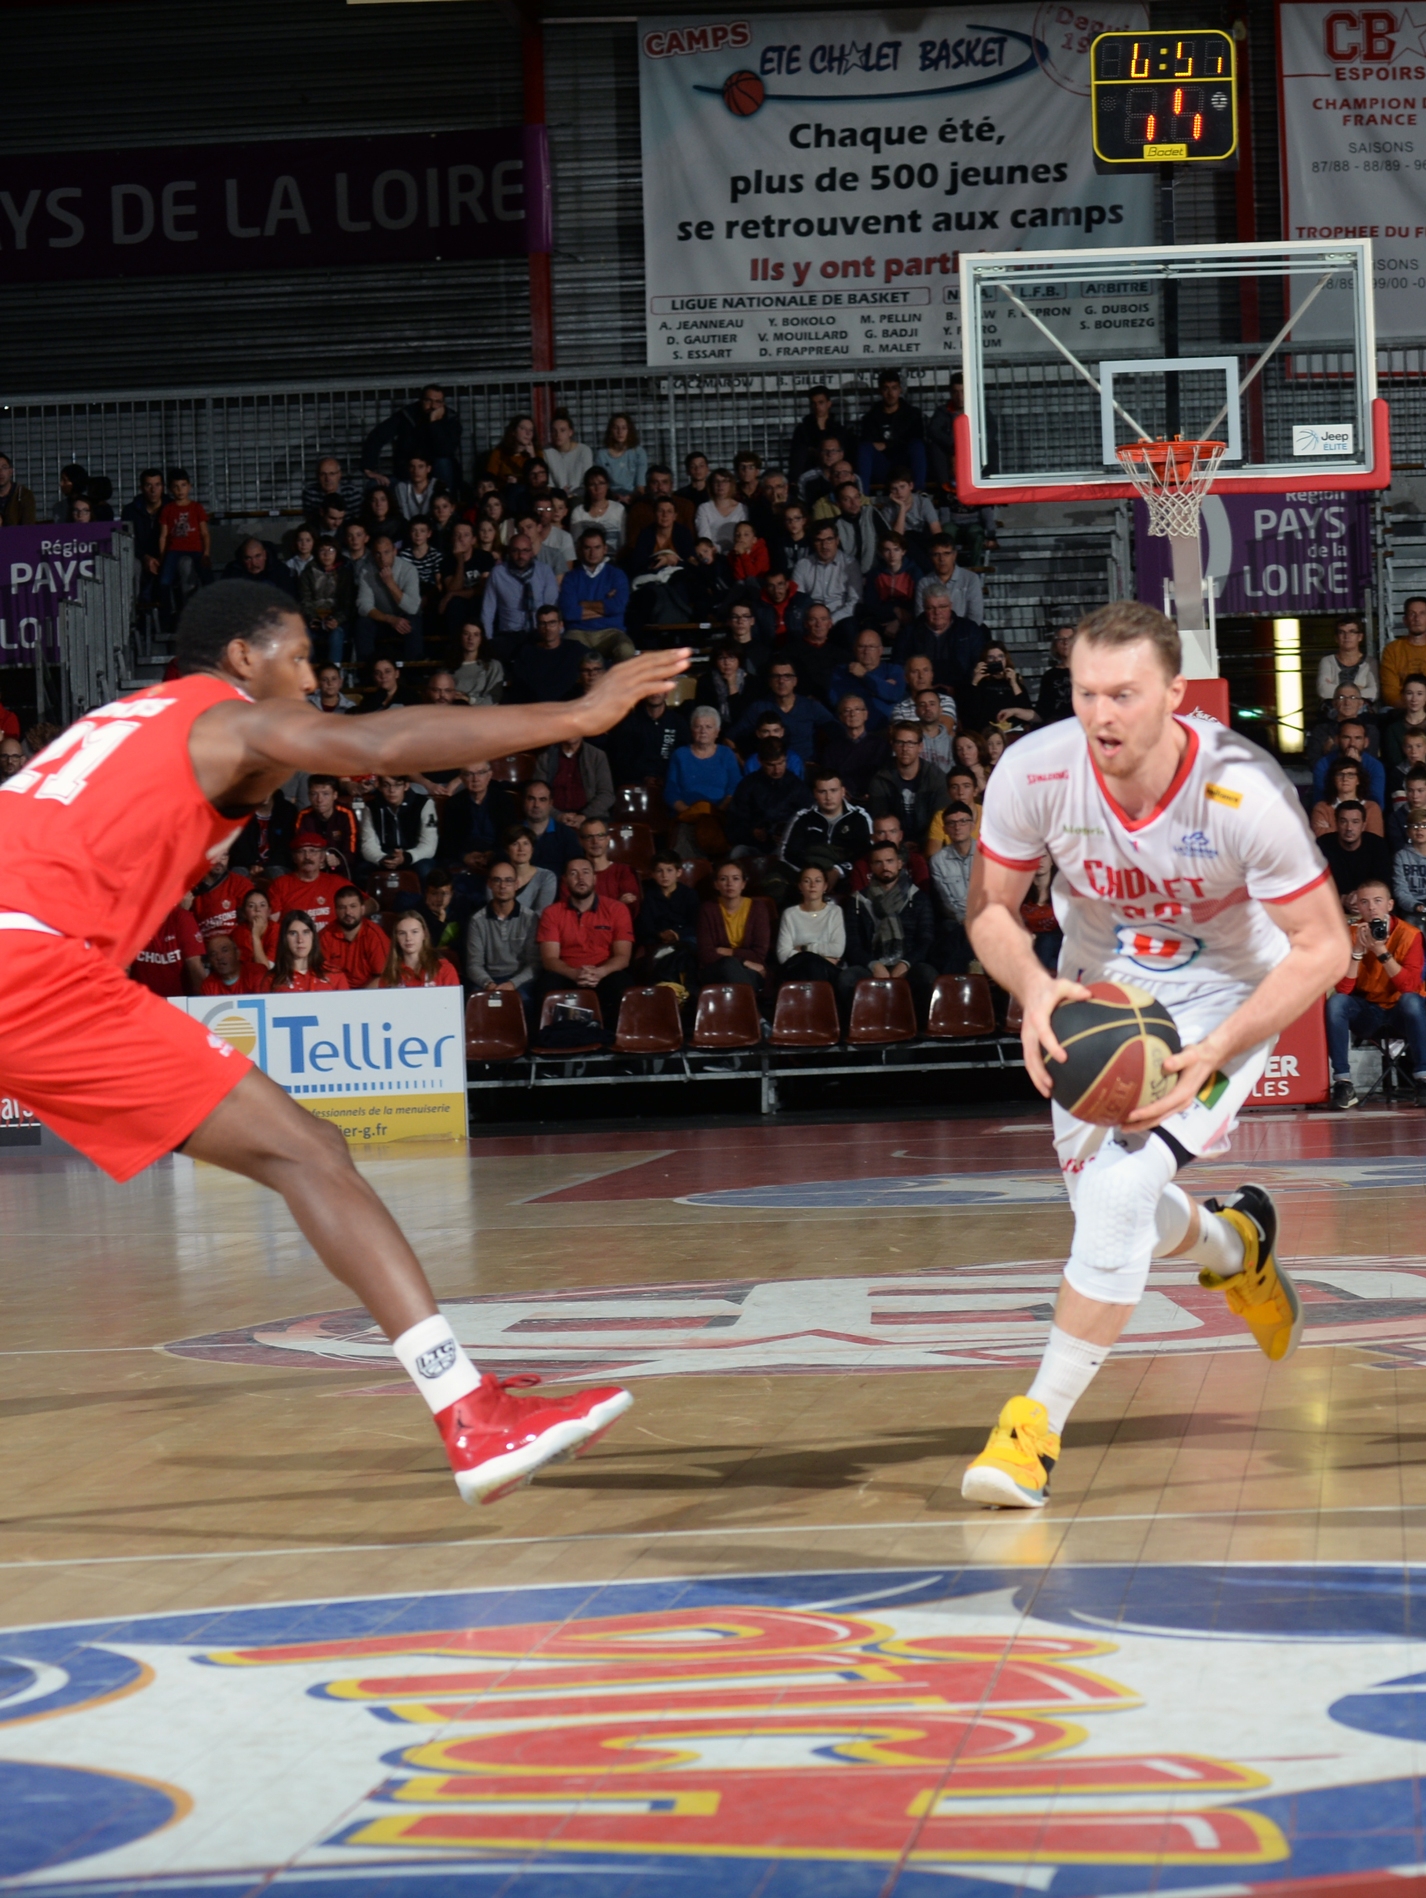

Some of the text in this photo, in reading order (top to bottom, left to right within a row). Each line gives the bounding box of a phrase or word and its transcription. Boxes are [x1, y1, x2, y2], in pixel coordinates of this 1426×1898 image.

[645, 22, 750, 57] CAMPS
[1323, 9, 1400, 64] CB
[761, 37, 1007, 75] ETE BASKET
[1336, 66, 1426, 81] ESPOIRS
[1312, 98, 1416, 110] CHAMPION
[1342, 114, 1417, 126] FRANCE
[789, 116, 1006, 154] Chaque été,
[1146, 146, 1184, 157] Bodet
[1349, 141, 1414, 153] SAISONS
[1312, 161, 1350, 173] 87/88
[1363, 160, 1400, 172] 88/89
[730, 162, 1068, 203] plus de 500 jeunes
[110, 160, 526, 244] DE LA LOIRE
[677, 204, 1123, 241] se retrouvent aux camps
[1296, 226, 1379, 238] TROPHEE
[1385, 226, 1409, 238] DU
[750, 256, 875, 287] Ils y ont
[1020, 286, 1060, 298] L.F.B.
[1086, 281, 1148, 294] ARBITRE
[671, 292, 910, 310] LIGUE NATIONALE DE BASKET
[1085, 303, 1149, 315] G. DUBOIS
[659, 319, 744, 330] A. JEANNEAU
[769, 316, 836, 327] Y. BOKOLO
[860, 313, 922, 324] M. PELLIN
[1080, 318, 1155, 330] S. BOUREZG
[667, 334, 737, 345] D. GAUTIER
[758, 330, 848, 342] V. MOUILLARD
[865, 328, 918, 338] G. BADJI
[673, 349, 732, 359] S. ESSART
[759, 345, 849, 357] D. FRAPPREAU
[863, 343, 921, 353] R. MALET
[1321, 431, 1349, 442] Jeep
[1254, 506, 1346, 541] PAYS
[41, 539, 98, 557] Région
[1307, 542, 1348, 558] de la
[1243, 562, 1349, 597] LOIRE
[136, 949, 182, 965] CHOLET
[272, 1015, 455, 1074] Tellier
[369, 1103, 451, 1116] de la menuiserie
